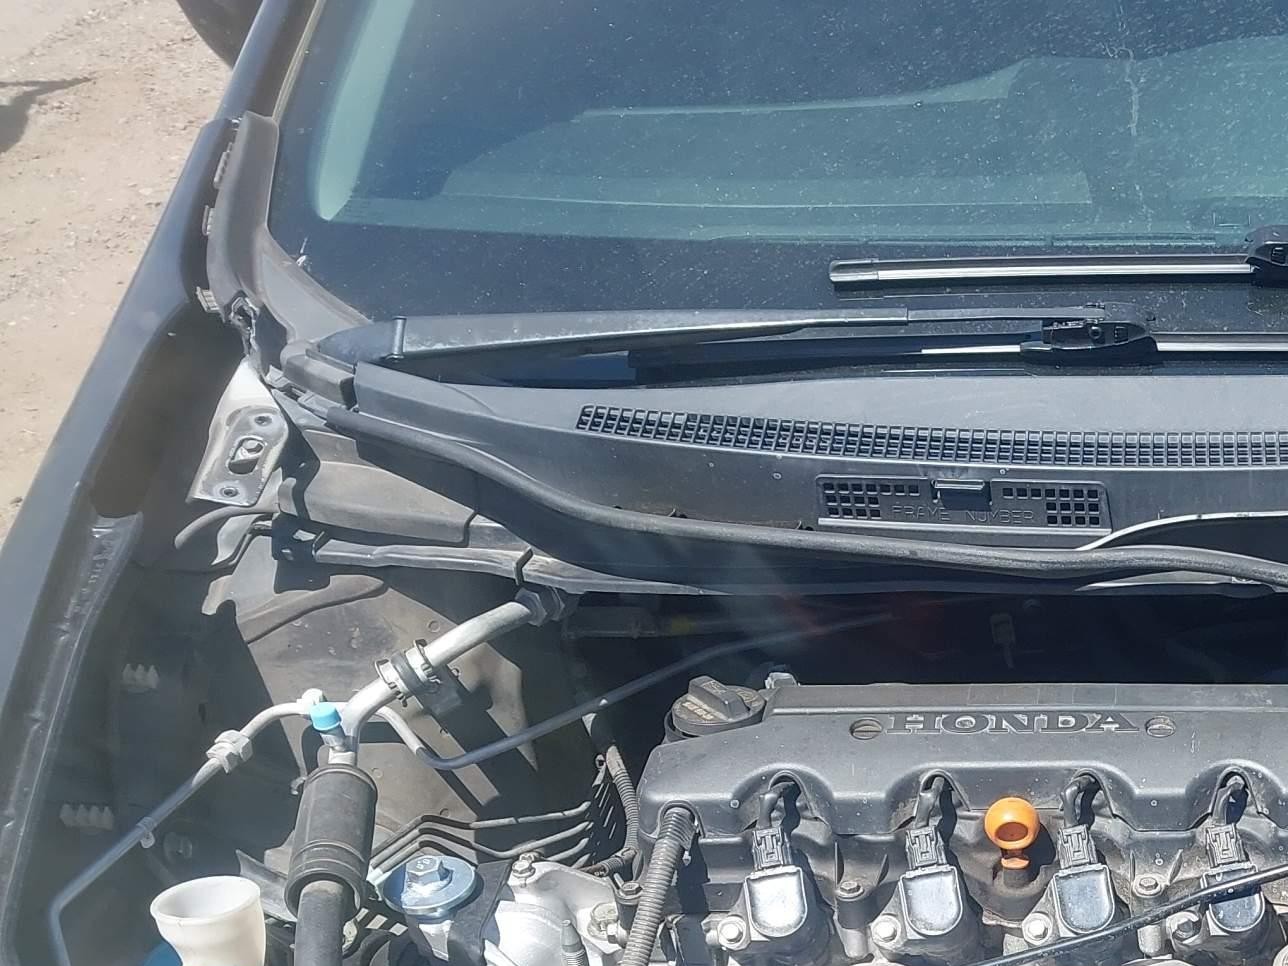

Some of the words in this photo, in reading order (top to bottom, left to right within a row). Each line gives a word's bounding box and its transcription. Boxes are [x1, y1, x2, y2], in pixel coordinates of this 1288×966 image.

[892, 505, 950, 521] FRAME
[965, 509, 1034, 524] NUMBER
[886, 712, 1140, 734] HONDA
